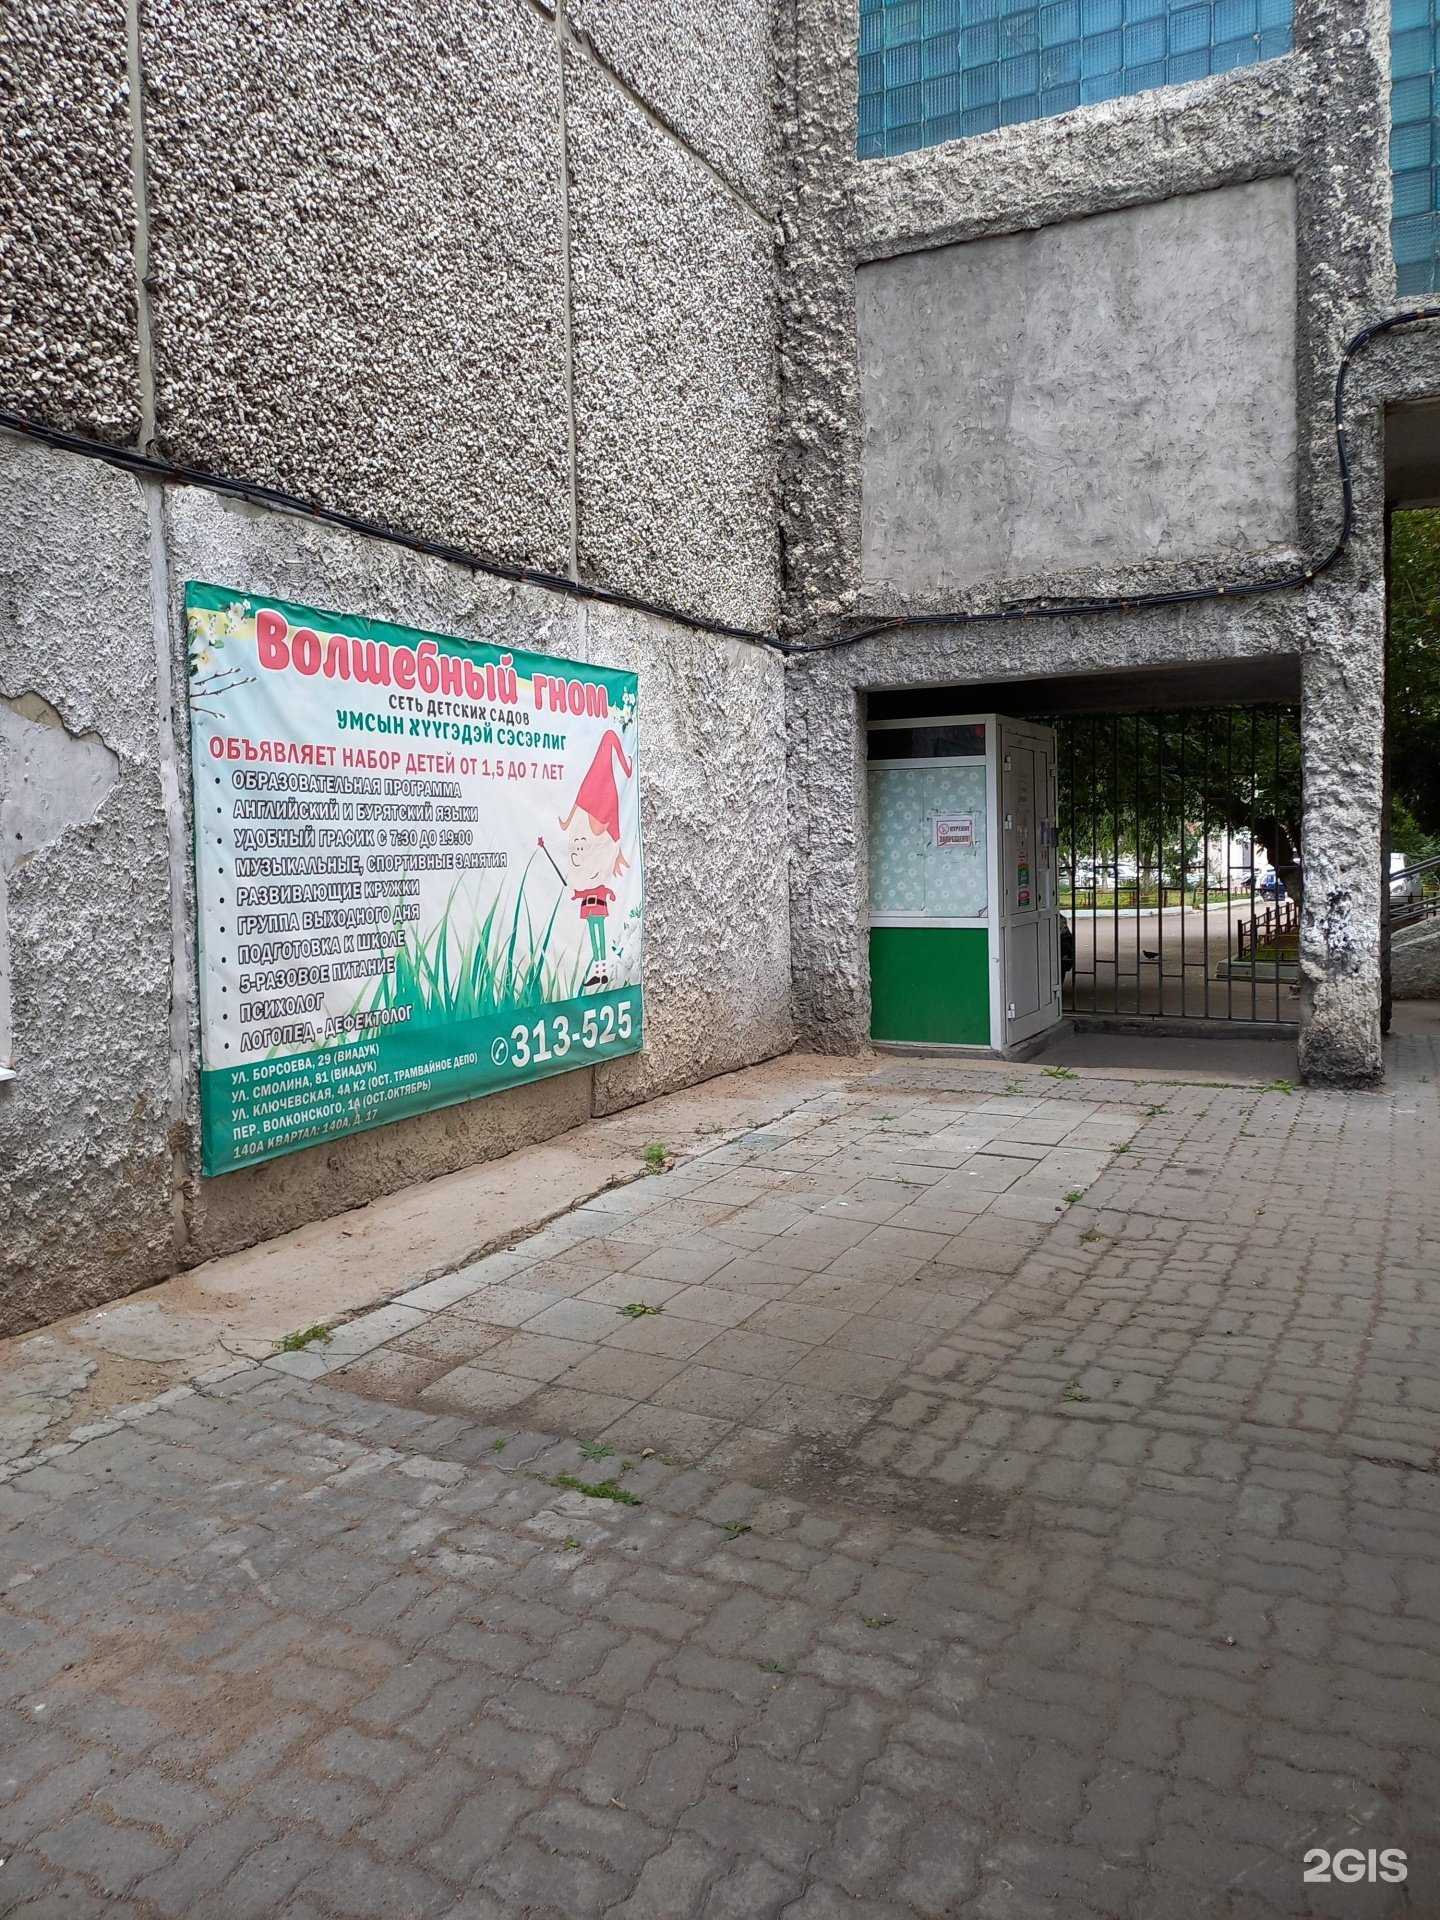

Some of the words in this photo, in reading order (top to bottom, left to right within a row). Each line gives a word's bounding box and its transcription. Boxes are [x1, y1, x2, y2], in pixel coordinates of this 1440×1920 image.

[256, 610, 518, 705] Волшебный
[533, 672, 609, 719] гном
[336, 709, 404, 735] УМСЫН
[497, 728, 567, 751] СЭСЭРЛИГ
[389, 694, 423, 712] СЕТЬ
[427, 700, 487, 720] ДЕТСКИХ
[490, 709, 530, 727] САДОВ
[209, 736, 336, 767] ОБЪЯВЛЯЕТ
[343, 748, 401, 771] НАБОР
[406, 751, 455, 775] ДЕТЕЙ
[460, 757, 477, 776] ОТ
[482, 759, 504, 780] 1,5
[508, 761, 526, 780] ДО
[531, 762, 538, 780] 7
[542, 764, 564, 781] ЛЕТ
[232, 770, 381, 795] ОБРАЗОВАТЕЛЬНАЯ
[384, 779, 462, 798] ПРОГРАММА
[233, 797, 339, 820] АНГЛИЙСКИЙ
[342, 803, 353, 820] И
[356, 801, 433, 822] БУРЯТСКИЙ
[435, 807, 479, 822] ЯЗЫКИ
[233, 825, 316, 850] УДОБНЫЙ
[318, 829, 375, 847] ГРАФИК
[377, 829, 387, 847] С
[389, 829, 418, 847] 7:30
[419, 829, 438, 849] ДО
[439, 829, 473, 846] 19:00
[235, 856, 365, 877] МУЗЫКАЛЬНЫЕ,
[367, 853, 453, 873] СПОРТИВНЫЕ
[455, 852, 507, 869] ЗАНЯТИЯ
[237, 882, 361, 906] РАЗВИВАЮЩИЕ
[364, 879, 420, 897] КРУЖКИ
[237, 913, 299, 935] ГРУППА
[303, 907, 390, 930] ВЫХОДНОГО
[393, 904, 420, 924] ДНЯ
[238, 937, 341, 965] ПОДГОТОВКА
[343, 936, 354, 952] К
[356, 930, 406, 949] ШКОЛЕ
[239, 965, 330, 993] 5-РАЗОВОЕ
[332, 957, 396, 981] ПИТАНИЕ
[240, 993, 324, 1023] ПСИХОЛОГ
[240, 1022, 315, 1052] ЛОГОПЕД
[324, 1005, 413, 1037] ДЕФЕКТОЛОГ
[511, 1001, 632, 1068] 313-525
[231, 1071, 249, 1085] УЛ.
[252, 1058, 316, 1080] БОРСОЕВА,
[317, 1054, 331, 1067] 29
[333, 1043, 379, 1064] (ВИАДУК)
[231, 1089, 249, 1104] УЛ.
[252, 1076, 313, 1099] СМОЛИНА,
[315, 1072, 329, 1085] 81
[330, 1060, 377, 1082] (ВИАДУК)
[231, 1108, 249, 1123] УЛ.
[252, 1087, 335, 1117] КЛЮЧЕВСКАЯ,
[337, 1084, 351, 1096] 4А
[353, 1079, 366, 1092] К2
[367, 1074, 393, 1091] (ОСТ.
[393, 1058, 452, 1082] ТРАМВАЙНОЕ
[453, 1052, 478, 1068] ДЕПО)
[233, 1124, 260, 1140] ПЕР.
[263, 1102, 345, 1133] ВОЛКОНСКОГО,
[347, 1097, 361, 1111] 1А
[233, 1140, 264, 1159] 140А
[365, 1109, 378, 1121] 17
